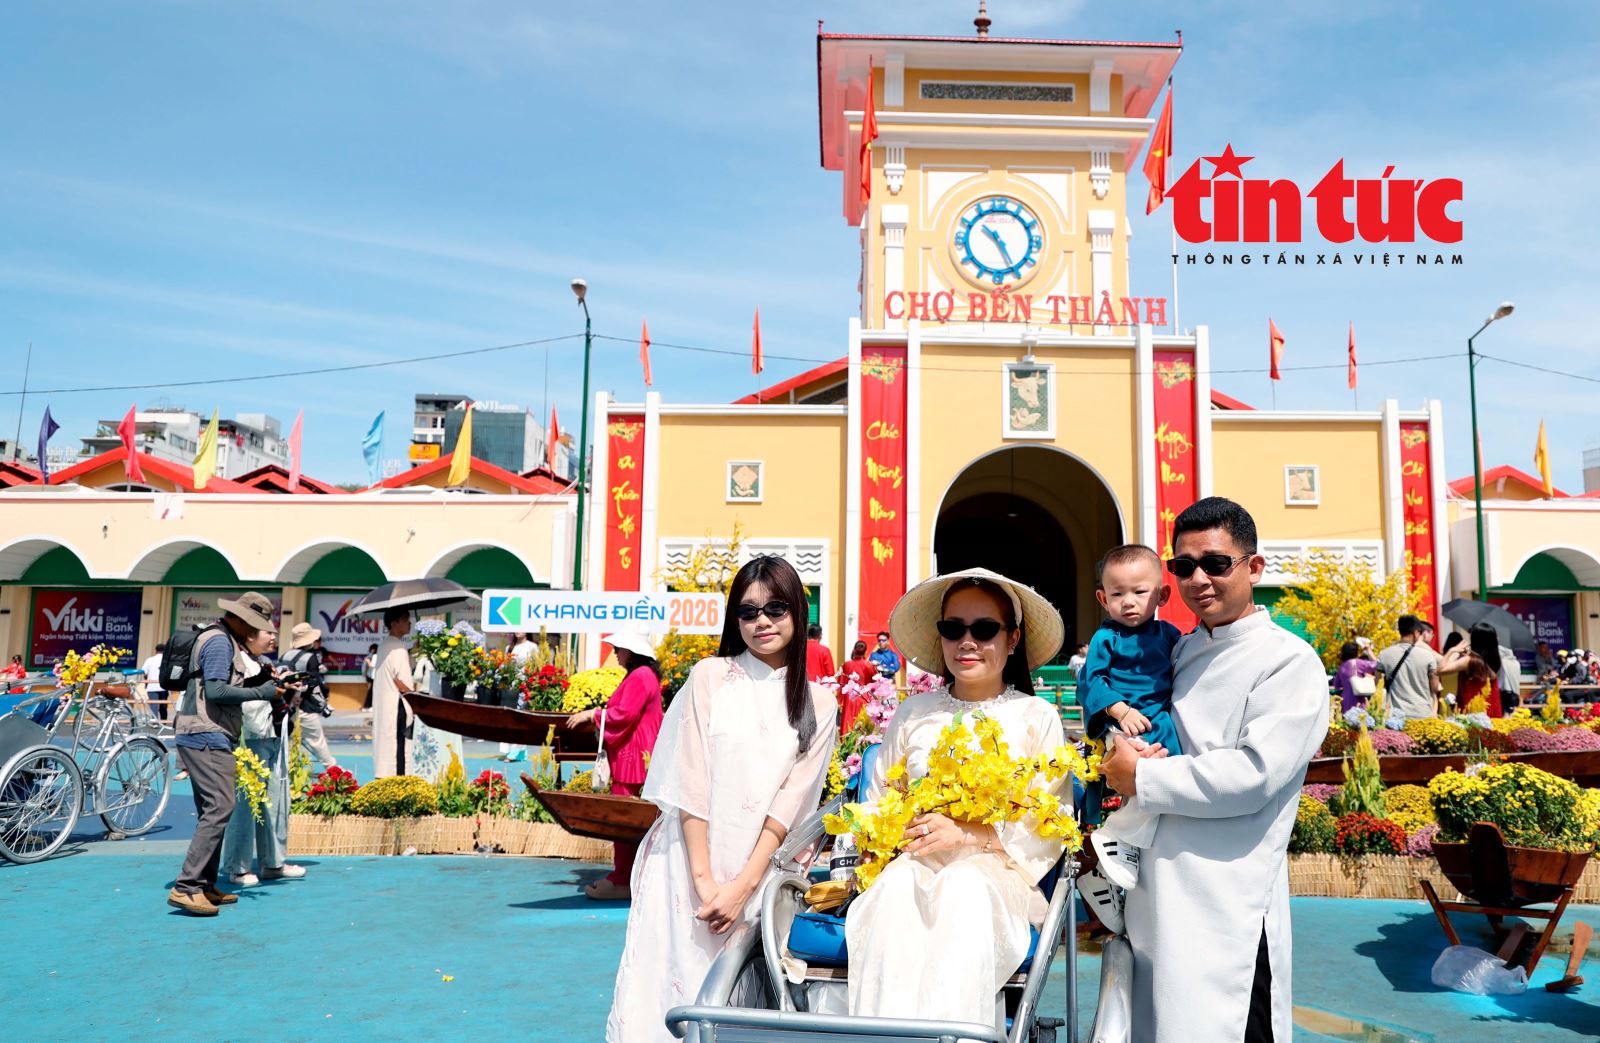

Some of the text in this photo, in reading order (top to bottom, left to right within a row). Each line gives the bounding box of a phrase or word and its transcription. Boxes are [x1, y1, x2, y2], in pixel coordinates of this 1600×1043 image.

[884, 284, 1168, 326] CHỢ BẾN THÀNH
[866, 420, 900, 440] Chúc
[1154, 420, 1193, 459] Happy
[42, 597, 105, 632] Vikki
[105, 622, 134, 632] Bank
[528, 595, 719, 627] KHANG ĐIỀN 2026
[1537, 627, 1564, 637] Bank
